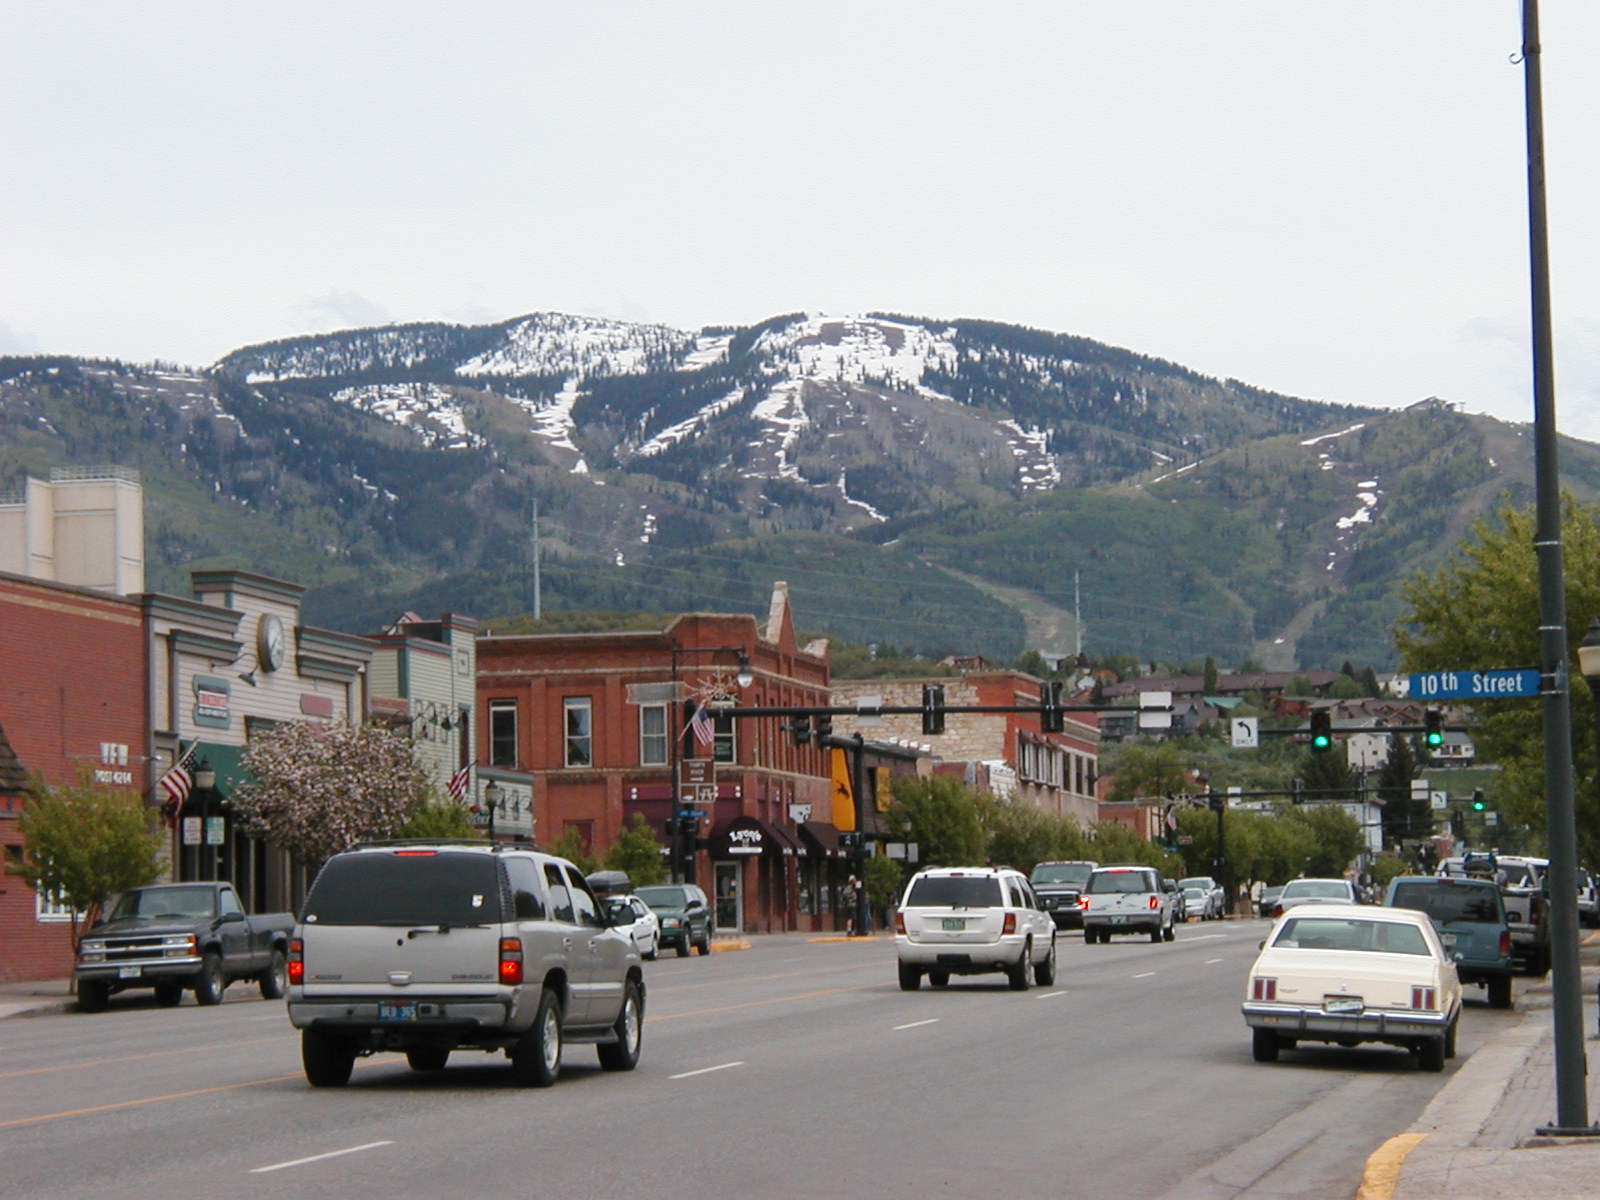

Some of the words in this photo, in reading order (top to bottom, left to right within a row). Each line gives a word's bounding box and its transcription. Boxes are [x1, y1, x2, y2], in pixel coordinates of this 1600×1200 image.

[1420, 672, 1459, 695] 10th
[1472, 672, 1523, 693] Street
[100, 742, 129, 766] VFW
